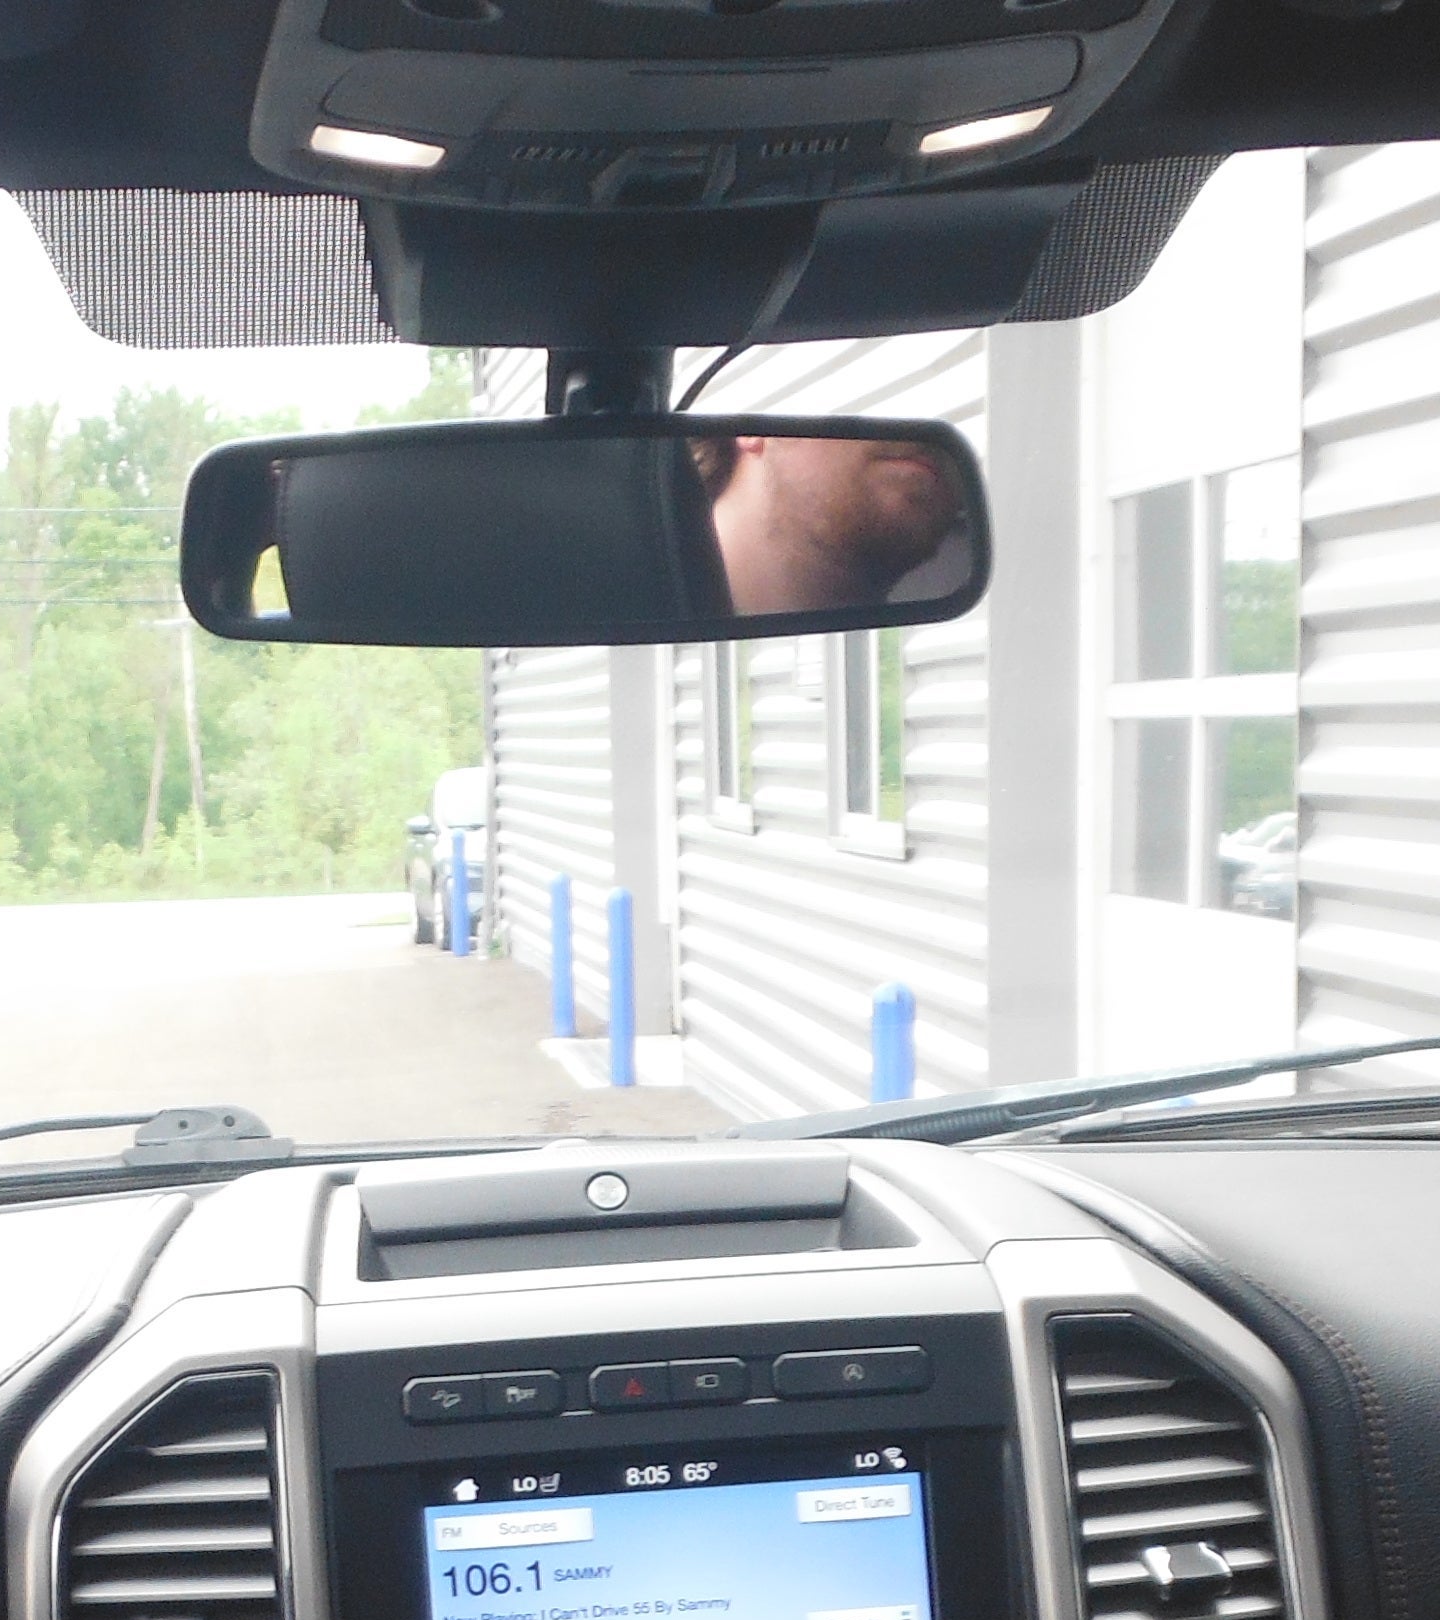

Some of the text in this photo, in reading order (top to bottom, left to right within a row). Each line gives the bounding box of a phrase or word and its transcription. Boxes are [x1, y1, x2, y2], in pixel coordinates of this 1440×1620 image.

[854, 1452, 880, 1468] LO
[625, 1461, 718, 1486] 8:05 65°
[513, 1476, 538, 1492] LO
[815, 1495, 896, 1513] Direct Tune
[442, 1527, 463, 1539] FM
[498, 1520, 558, 1536] Sources
[443, 1561, 614, 1597] 106.1 SAMMY
[549, 1606, 588, 1620] Can't
[592, 1603, 629, 1618] Drive
[633, 1601, 651, 1615] 55
[655, 1600, 673, 1616] By
[677, 1597, 732, 1614] Sammy
